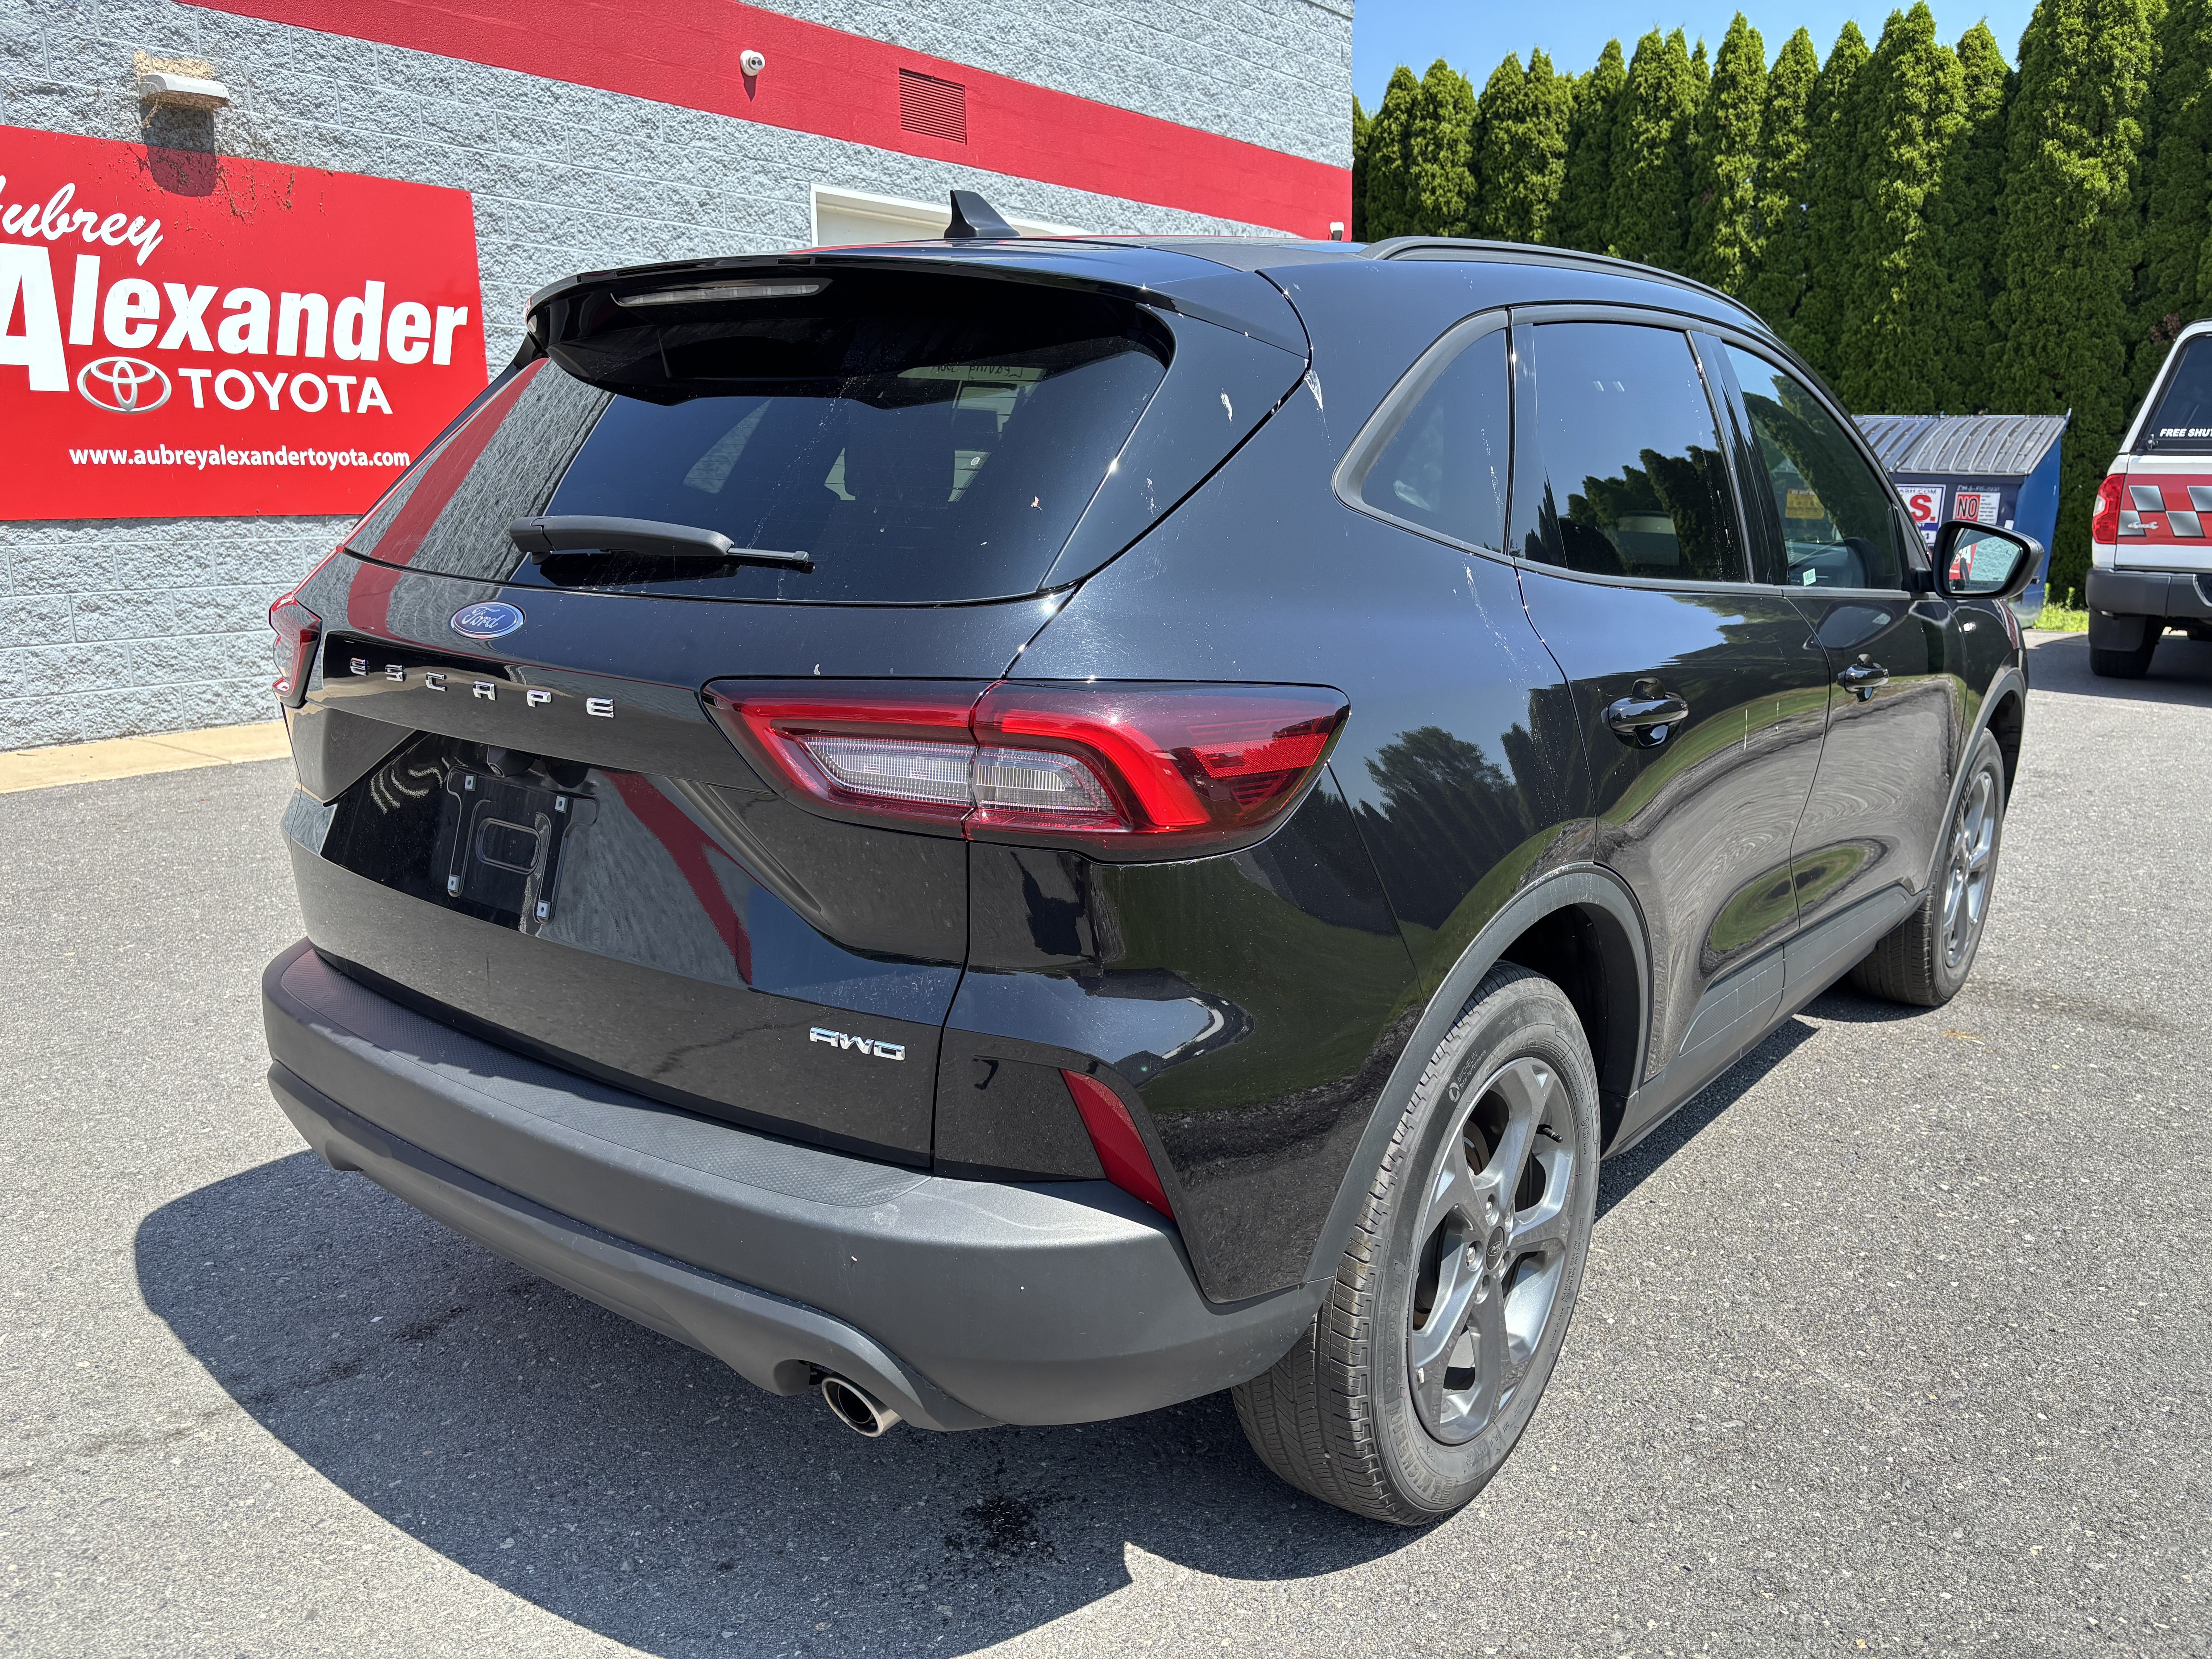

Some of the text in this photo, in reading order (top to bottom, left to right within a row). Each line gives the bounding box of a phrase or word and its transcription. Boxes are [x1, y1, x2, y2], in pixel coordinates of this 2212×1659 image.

[0, 175, 163, 266] ubrey
[0, 242, 468, 392] Alexander
[178, 368, 393, 414] TOYOTA
[2160, 428, 2187, 437] FREE
[69, 444, 410, 471] www.aubreyalexandertoyota.com
[1956, 496, 1978, 519] NO
[462, 606, 506, 629] Ford
[350, 657, 615, 718] ESCAPE
[809, 1026, 906, 1061] AWD
[1456, 1050, 1478, 1083] MICHELIN
[1466, 1049, 1487, 1078] Performance
[1389, 1407, 1433, 1493] MICHELIN
